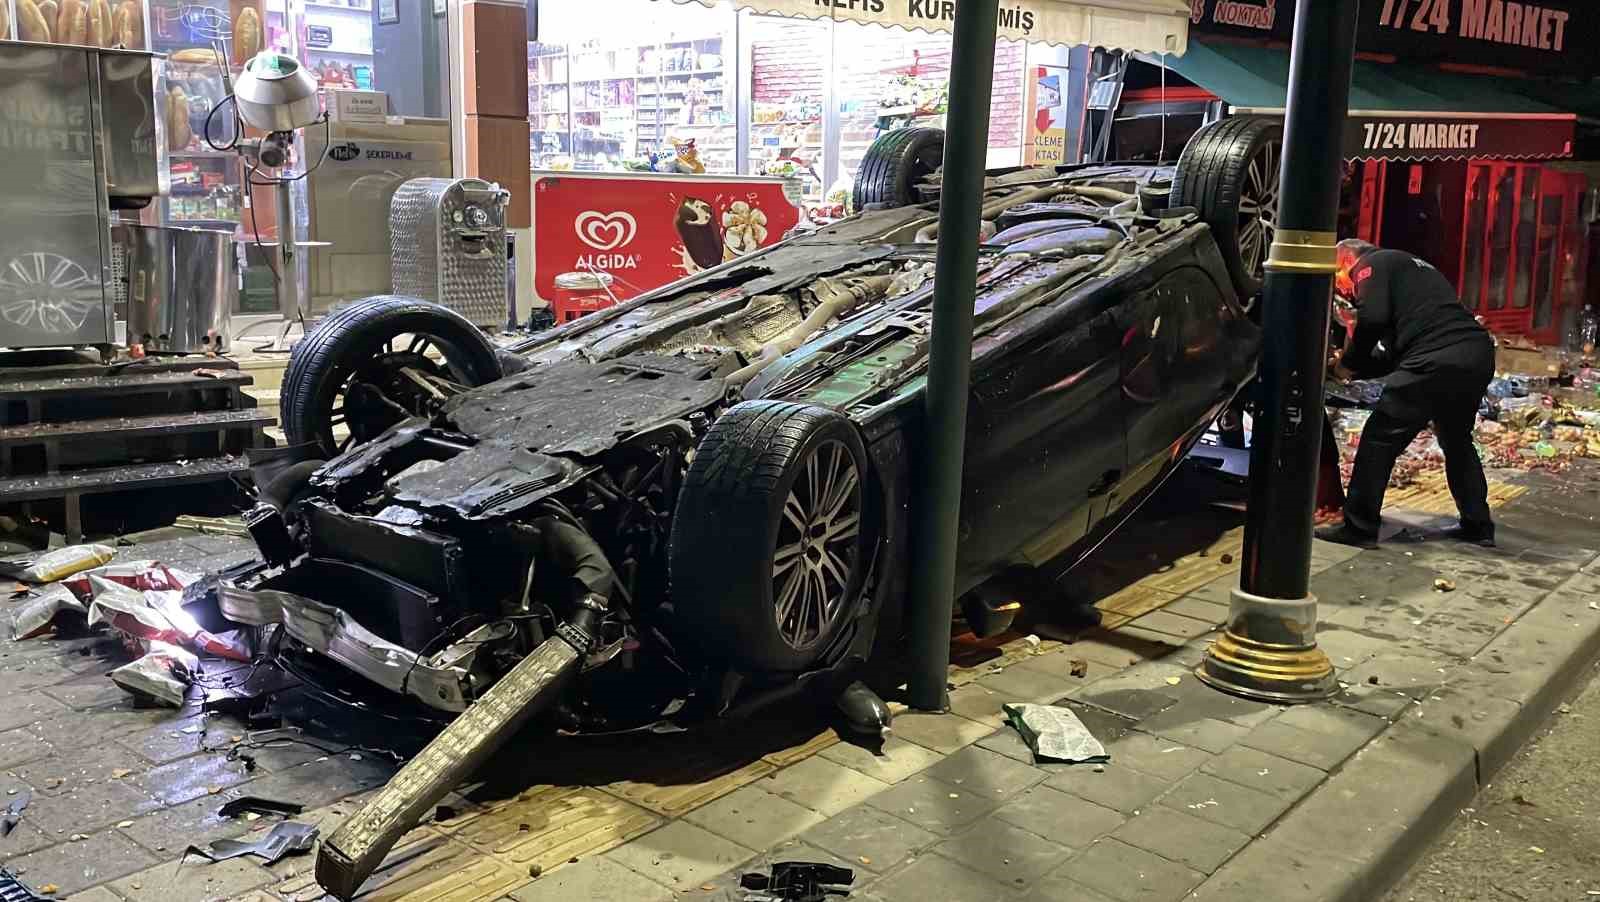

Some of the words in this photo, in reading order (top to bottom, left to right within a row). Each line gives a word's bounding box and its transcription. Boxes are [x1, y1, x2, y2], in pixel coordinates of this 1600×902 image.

[1459, 0, 1569, 51] MARKET
[1363, 123, 1406, 149] 7/24
[1409, 123, 1479, 149] MARKET
